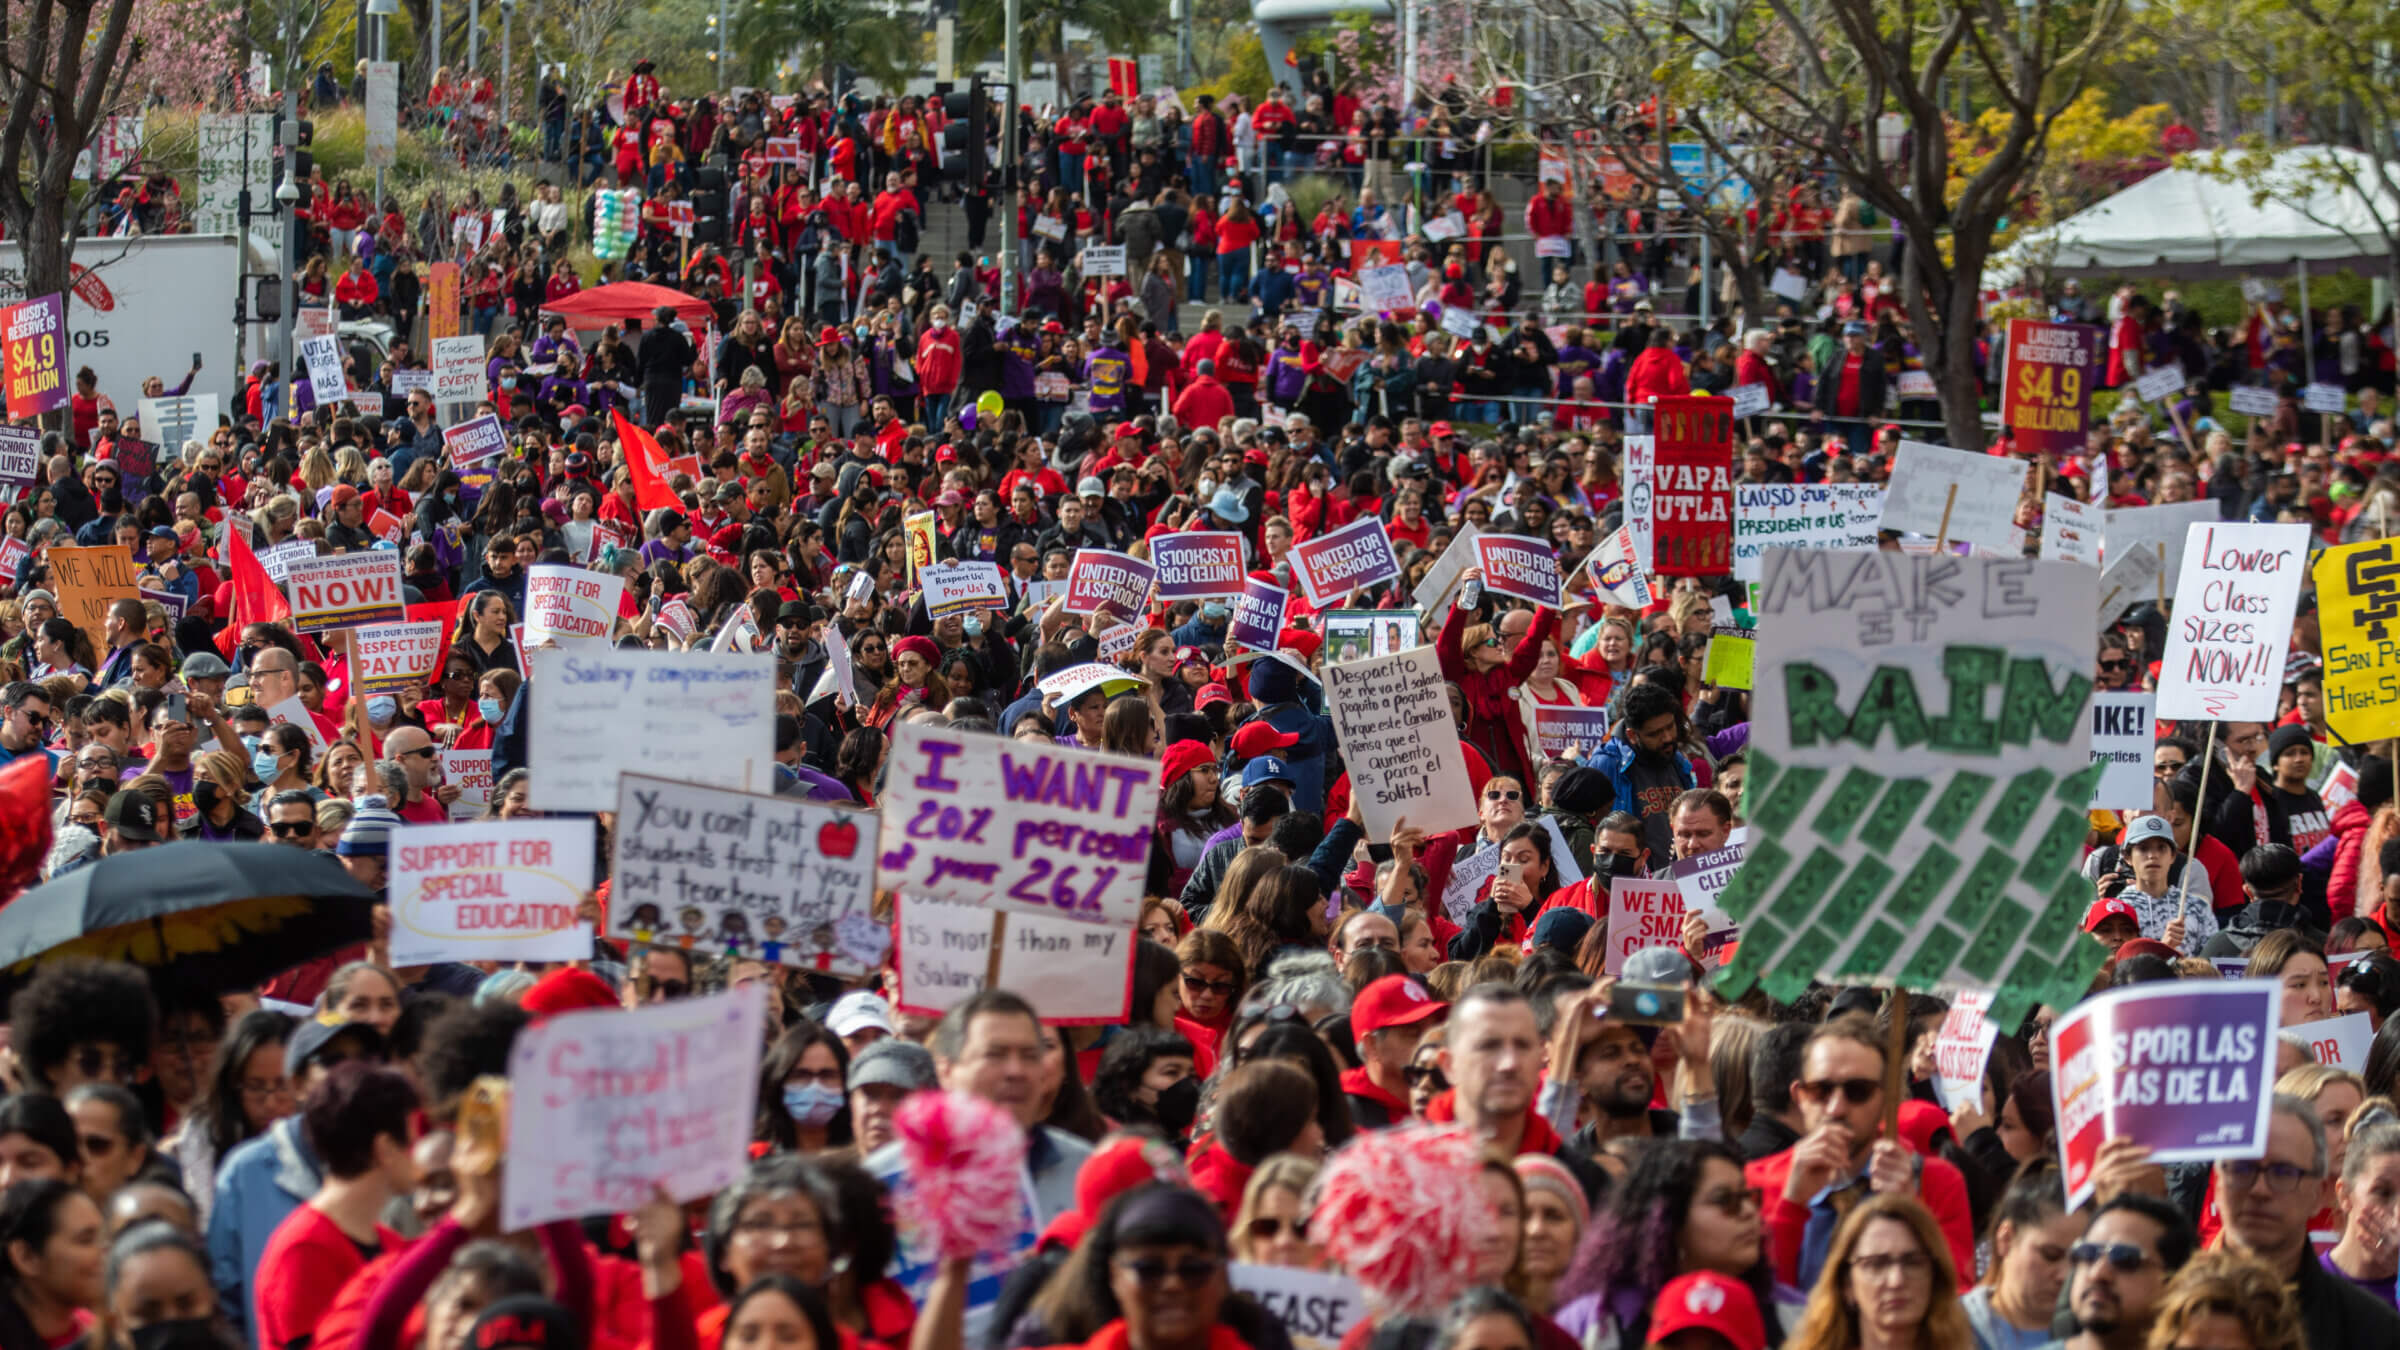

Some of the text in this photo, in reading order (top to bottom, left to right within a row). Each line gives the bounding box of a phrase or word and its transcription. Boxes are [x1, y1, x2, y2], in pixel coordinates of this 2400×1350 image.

[13, 302, 49, 324] LAUSD'S
[8, 315, 56, 342] RESERVE IS
[2027, 328, 2079, 346] LAUSD'S
[12, 334, 56, 376] $4.9
[304, 341, 332, 356] UTLA
[435, 341, 473, 354] Teacher
[2016, 344, 2087, 366] RESERVE IS
[311, 356, 335, 368] EXIGE
[436, 356, 485, 370] Librarians
[13, 368, 59, 399] BILLION
[317, 375, 338, 389] MÁS
[439, 373, 479, 386] EVERY
[2018, 366, 2081, 407] $4.9
[2014, 404, 2080, 432] BILLION
[22, 429, 35, 438] FOR
[450, 425, 496, 448] UNITED FOR
[464, 434, 499, 454] SCHOOLS
[1, 453, 35, 474] LIVES!
[1630, 445, 1651, 465] Mr.
[1655, 465, 1730, 492] VAPA
[1655, 496, 1728, 522] UTLA
[1739, 487, 1830, 506] LAUSD SUP
[1633, 518, 1649, 532] To
[1738, 512, 1845, 536] PRESIDENT US
[303, 561, 324, 571] HELP
[325, 556, 368, 568] STUDENTS
[369, 553, 396, 563] LEARN
[1160, 548, 1238, 566] LA SCHOOLS
[1307, 532, 1382, 571] UNITED FOR
[1486, 547, 1555, 575] UNITED FOR
[2202, 527, 2292, 573] Lower
[54, 556, 84, 588] WE
[89, 554, 137, 588] WILL
[291, 563, 397, 583] EQUITABLE WAGES
[935, 572, 984, 585] Respect Us!
[1078, 563, 1148, 592] UNITED FOR
[1161, 565, 1240, 583] UNITED FOR
[1314, 549, 1388, 586] LA SCHOOLS
[1490, 561, 1556, 591] LA SCHOOLS
[298, 577, 396, 610] NOW!
[530, 575, 601, 599] SUPPORT FOR
[943, 584, 984, 599] Pay Us!
[1075, 579, 1142, 611] LA SCHOOLS
[1762, 551, 2038, 618] MAKE
[2203, 580, 2271, 614] Class
[534, 595, 572, 612] SPECIAL
[1243, 596, 1260, 612] POR
[1260, 599, 1278, 616] LAS
[363, 626, 441, 639] FEED OUR STUDENTS
[544, 612, 609, 638] EDUCATION
[1251, 617, 1273, 632] DE LA
[1859, 610, 1938, 647] IT
[2184, 615, 2255, 644] Sizes
[357, 636, 439, 655] RESPECT US!
[361, 653, 435, 675] PAY US!
[562, 657, 770, 692] Salary comparisons:
[1331, 655, 1417, 686] Despacito
[2187, 643, 2273, 687] NOW!!
[1337, 673, 1443, 700] se me va el salario
[1383, 698, 1391, 708] a
[1394, 689, 1438, 714] poquito
[1784, 645, 2094, 757] RAIN
[1340, 708, 1447, 738] Porque este Carvalho
[1566, 722, 1584, 736] POR
[1584, 723, 1603, 737] LAS
[2093, 706, 2145, 736] IKE!
[1347, 730, 1421, 762] piensa que el
[1369, 747, 1431, 770] aumento
[2090, 750, 2141, 765] Practices
[914, 739, 1152, 819] I WANT
[1357, 755, 1441, 788] es para el
[1376, 775, 1431, 805] solito!
[634, 789, 807, 846] You put
[905, 800, 1154, 864] 20% percent
[399, 840, 552, 873] SUPPORT FOR
[622, 836, 715, 870] students
[726, 841, 776, 878] first
[818, 861, 862, 892] you
[420, 871, 508, 900] SPECIAL
[880, 842, 1119, 912] of your 26%
[621, 869, 662, 900] put
[678, 872, 782, 919] teachers
[1447, 895, 1471, 919] IS
[1623, 890, 1657, 913] WE
[456, 903, 580, 931] EDUCATION
[1016, 928, 1118, 957] than my
[2131, 1023, 2257, 1066] POR LAS
[2165, 1067, 2249, 1105] DE LA
